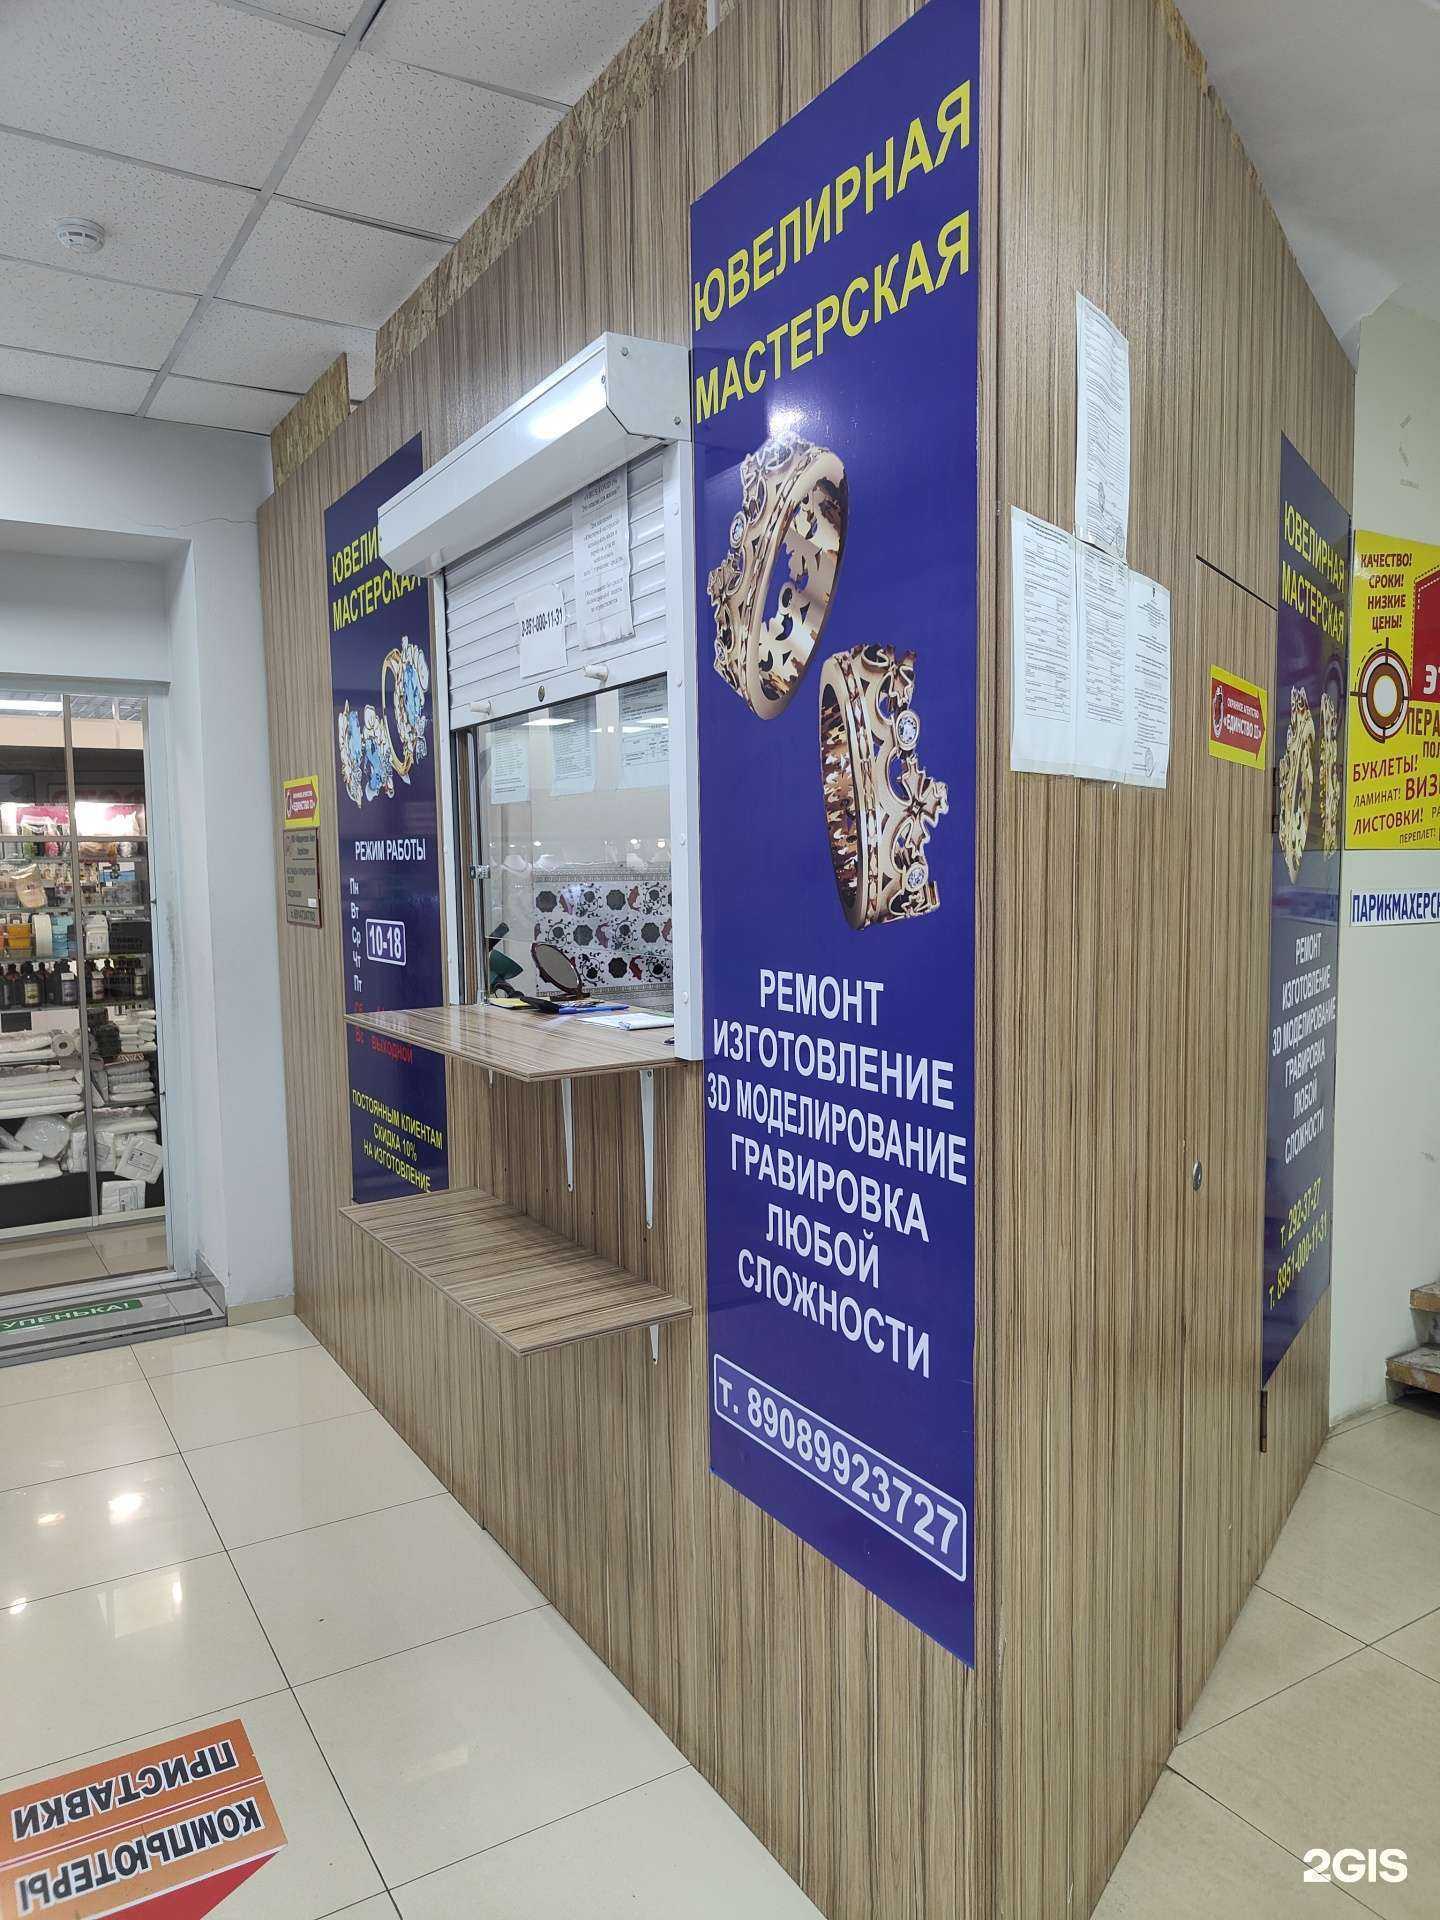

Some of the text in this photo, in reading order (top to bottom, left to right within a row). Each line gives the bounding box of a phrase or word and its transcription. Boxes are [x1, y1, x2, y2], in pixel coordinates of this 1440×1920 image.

[694, 79, 971, 332] ЮВЕЛИРНАЯ
[695, 209, 970, 424] МАСТЕРСКАЯ
[331, 525, 379, 588] ЮВЕЛИ
[1283, 500, 1345, 593] ЮВЕЛИРНАЯ
[1360, 553, 1413, 568] КАЧЕСТВО!
[1281, 560, 1345, 644] МАСТЕРСКАЯ
[1367, 594, 1406, 610] НИЗКИЕ
[1368, 574, 1404, 589] СРОКИ!
[1371, 614, 1403, 633] ЦЕНЫ!
[1423, 664, 1440, 695] Э
[1353, 754, 1418, 782] БУКЛЕТЫ!
[1405, 773, 1440, 801] ВИЗ
[1353, 787, 1401, 808] ЛАМИНАТ!
[1353, 807, 1424, 836] ЛИСТОВКИ!
[355, 838, 426, 861] РЕЖИМ РАБОТЫ
[350, 877, 359, 895] Пн
[350, 902, 359, 919] Вт
[352, 926, 361, 948] Ср
[352, 950, 361, 968] Чт
[369, 925, 402, 959] 10-18
[1295, 932, 1322, 965] РЕМОНТ
[354, 974, 362, 993] Пт
[760, 968, 884, 1026] РЕМОНТ
[1282, 965, 1331, 1011] ИЗГОТОВЛЕНИЕ
[1272, 996, 1336, 1057] 3D МОДЕЛИРОВАНИЕ
[713, 1018, 954, 1111] ИЗГОТОВЛЕНИЕ
[1285, 1036, 1326, 1089] ГРАВИРОВКА
[1293, 1073, 1318, 1119] ЛЮБОЙ
[352, 1089, 443, 1151] ПОСТОЯННЫМ КЛИЕНТАМ
[373, 1122, 417, 1161] СКИДКА 10%
[707, 1071, 968, 1185] 3D МОДЕЛИРОВАНИЕ
[1285, 1110, 1325, 1164] СЛОЖНОСТИ
[363, 1138, 431, 1193] НА ИЗГОТОВЛЕНИЕ
[731, 1132, 930, 1243] ГРАВИРОВКА
[766, 1202, 879, 1289] ЛЮБОЙ
[738, 1248, 930, 1379] СЛОЖНОСТИ
[747, 1387, 958, 1554] 89089923727
[13, 1740, 238, 1841] ПРИСТАВКИ
[18, 1798, 263, 1914] КОМПЬЮТЕРЫ
